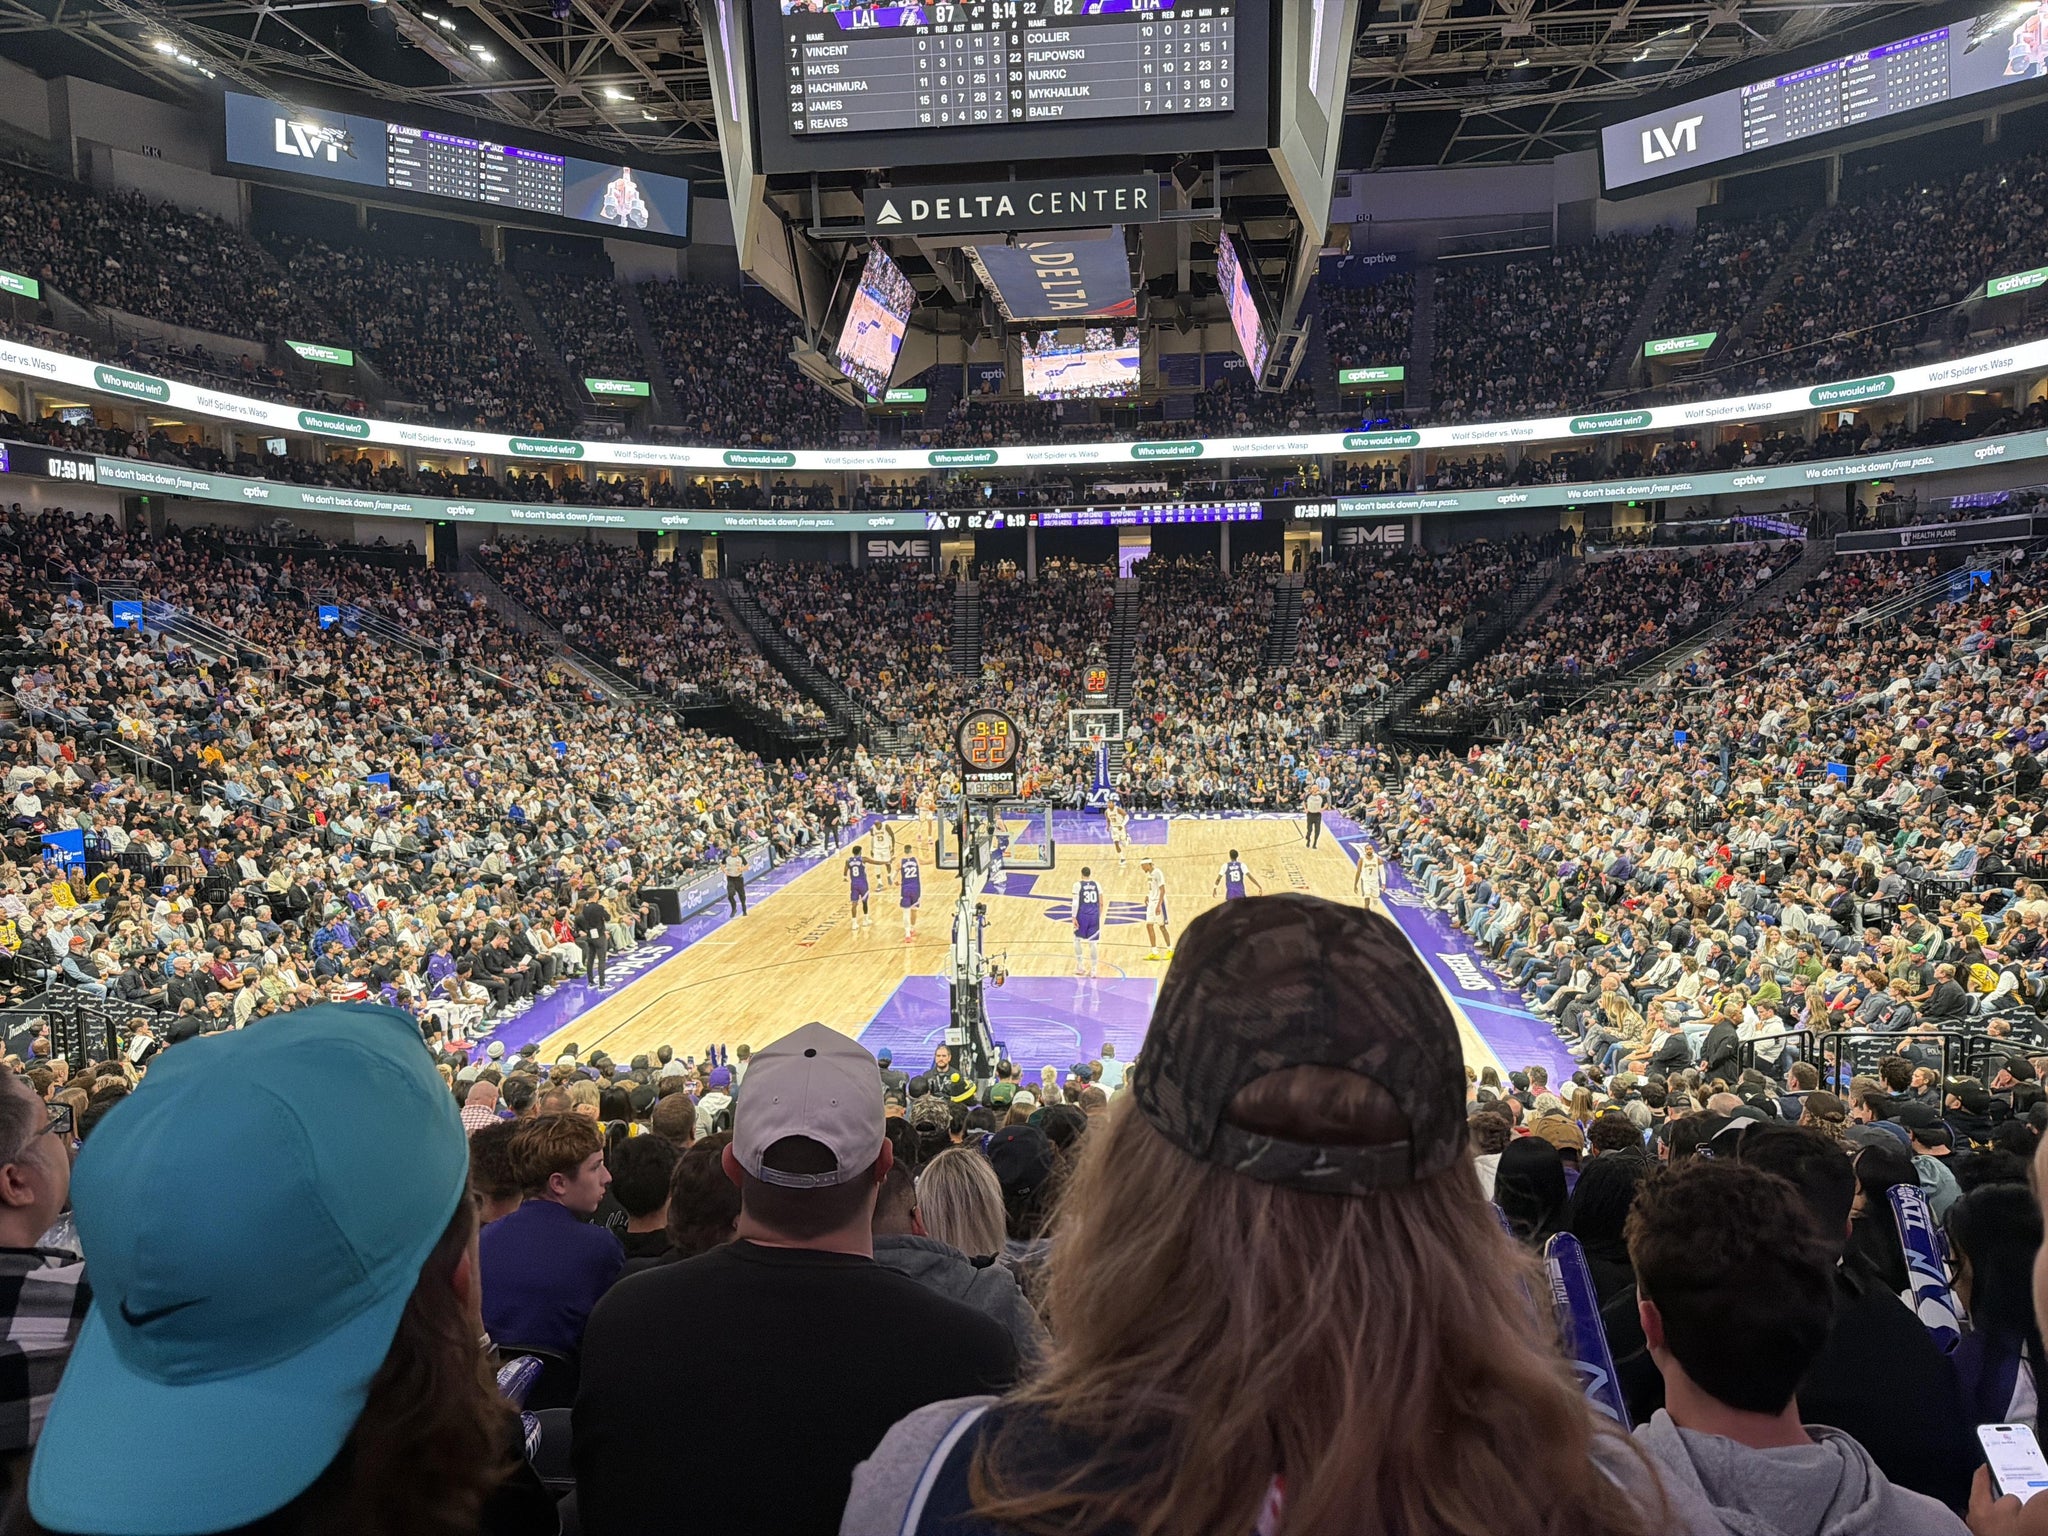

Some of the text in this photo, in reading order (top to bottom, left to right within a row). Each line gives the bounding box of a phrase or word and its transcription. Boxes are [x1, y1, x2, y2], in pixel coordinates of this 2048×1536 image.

[972, 3, 1016, 19] 4TH 9:14
[1023, 4, 1036, 14] 22
[1054, 0, 1072, 15] 82
[853, 10, 879, 27] LAL
[936, 6, 954, 22] 87
[1142, 12, 1153, 20] PTS
[1162, 11, 1174, 19] REB
[1181, 10, 1193, 18] AST
[807, 33, 824, 41] NAME
[917, 26, 928, 34] PTS
[972, 23, 983, 31] MIN
[1012, 33, 1069, 44] 8 COLLIER
[791, 46, 848, 57] 7 VINCENT
[1010, 50, 1085, 62] 22 FILIPOWSKI
[1853, 53, 1869, 63] JAZZ
[792, 65, 839, 75] 11 HAYES
[1010, 70, 1066, 80] 30 NURKIC
[791, 81, 867, 93] 28 HACHIMURA
[1752, 80, 1775, 92] LAKERS
[1011, 87, 1089, 98] 10 MYKHAILIUK
[792, 101, 842, 111] 23 JAMES
[1012, 106, 1063, 117] 19 BAILEY
[793, 118, 848, 129] 15 REAVES
[399, 127, 421, 137] LAKERS
[1642, 115, 1703, 164] LVT
[490, 144, 504, 153] JAZZ
[911, 188, 1148, 220] DELTA CENTER
[1363, 253, 1396, 265] aptive
[1030, 253, 1088, 310] DELTA
[1997, 276, 2031, 291] aptive
[296, 346, 326, 358] aptive
[1654, 340, 1686, 352] aptive
[1223, 358, 1245, 371] apti
[1929, 371, 1950, 382] Wolf
[1951, 366, 1978, 379] Spider
[1990, 358, 2013, 370] Wasp
[981, 369, 1005, 379] aptiv
[1349, 370, 1376, 381] aptive
[103, 373, 162, 396] Who would win?
[595, 382, 622, 391] aptive
[1818, 381, 1886, 400] Who would win?
[1686, 410, 1704, 418] Wolf
[1706, 407, 1734, 418] Spider
[1748, 401, 1772, 413] Wasp
[305, 416, 361, 432] Who would win?
[1578, 416, 1642, 430] Who would win?
[400, 430, 416, 440] Wolf
[418, 432, 441, 444] Spider
[455, 437, 475, 447] Wasp
[1452, 432, 1470, 440] Wolf
[1472, 430, 1498, 441] Spider
[1511, 427, 1533, 437] Wasp
[1351, 435, 1412, 446] Who would win?
[1975, 444, 2005, 459] aptive
[49, 459, 95, 482] 07:59 PM
[1806, 456, 1934, 478] We don't back down from pests.
[1734, 475, 1766, 487] aptive
[243, 485, 269, 498] aptive
[1568, 482, 1692, 499] We don't back down from pests.
[1341, 499, 1458, 512] We don't back down from pests.
[1498, 494, 1528, 505] aptive
[511, 510, 625, 523] We don't back down from pests.
[1295, 503, 1336, 518] 07:59 PM
[661, 515, 689, 525] aptive
[869, 517, 895, 527] aptive
[948, 516, 981, 528] 87 82
[1007, 514, 1025, 526] 9:13
[1337, 524, 1404, 544] SME
[1913, 529, 1957, 539] HEALTH PLANS
[868, 540, 930, 557] SME
[1088, 678, 1104, 690] 22
[977, 722, 1008, 736] 9:13
[972, 736, 1006, 762] 22
[852, 867, 859, 877] 8
[904, 867, 917, 878] 22
[1230, 871, 1240, 882] 19
[1083, 891, 1097, 903] 30
[1899, 1197, 1926, 1230] JAZZ
[1553, 1279, 1570, 1304] UTAH
